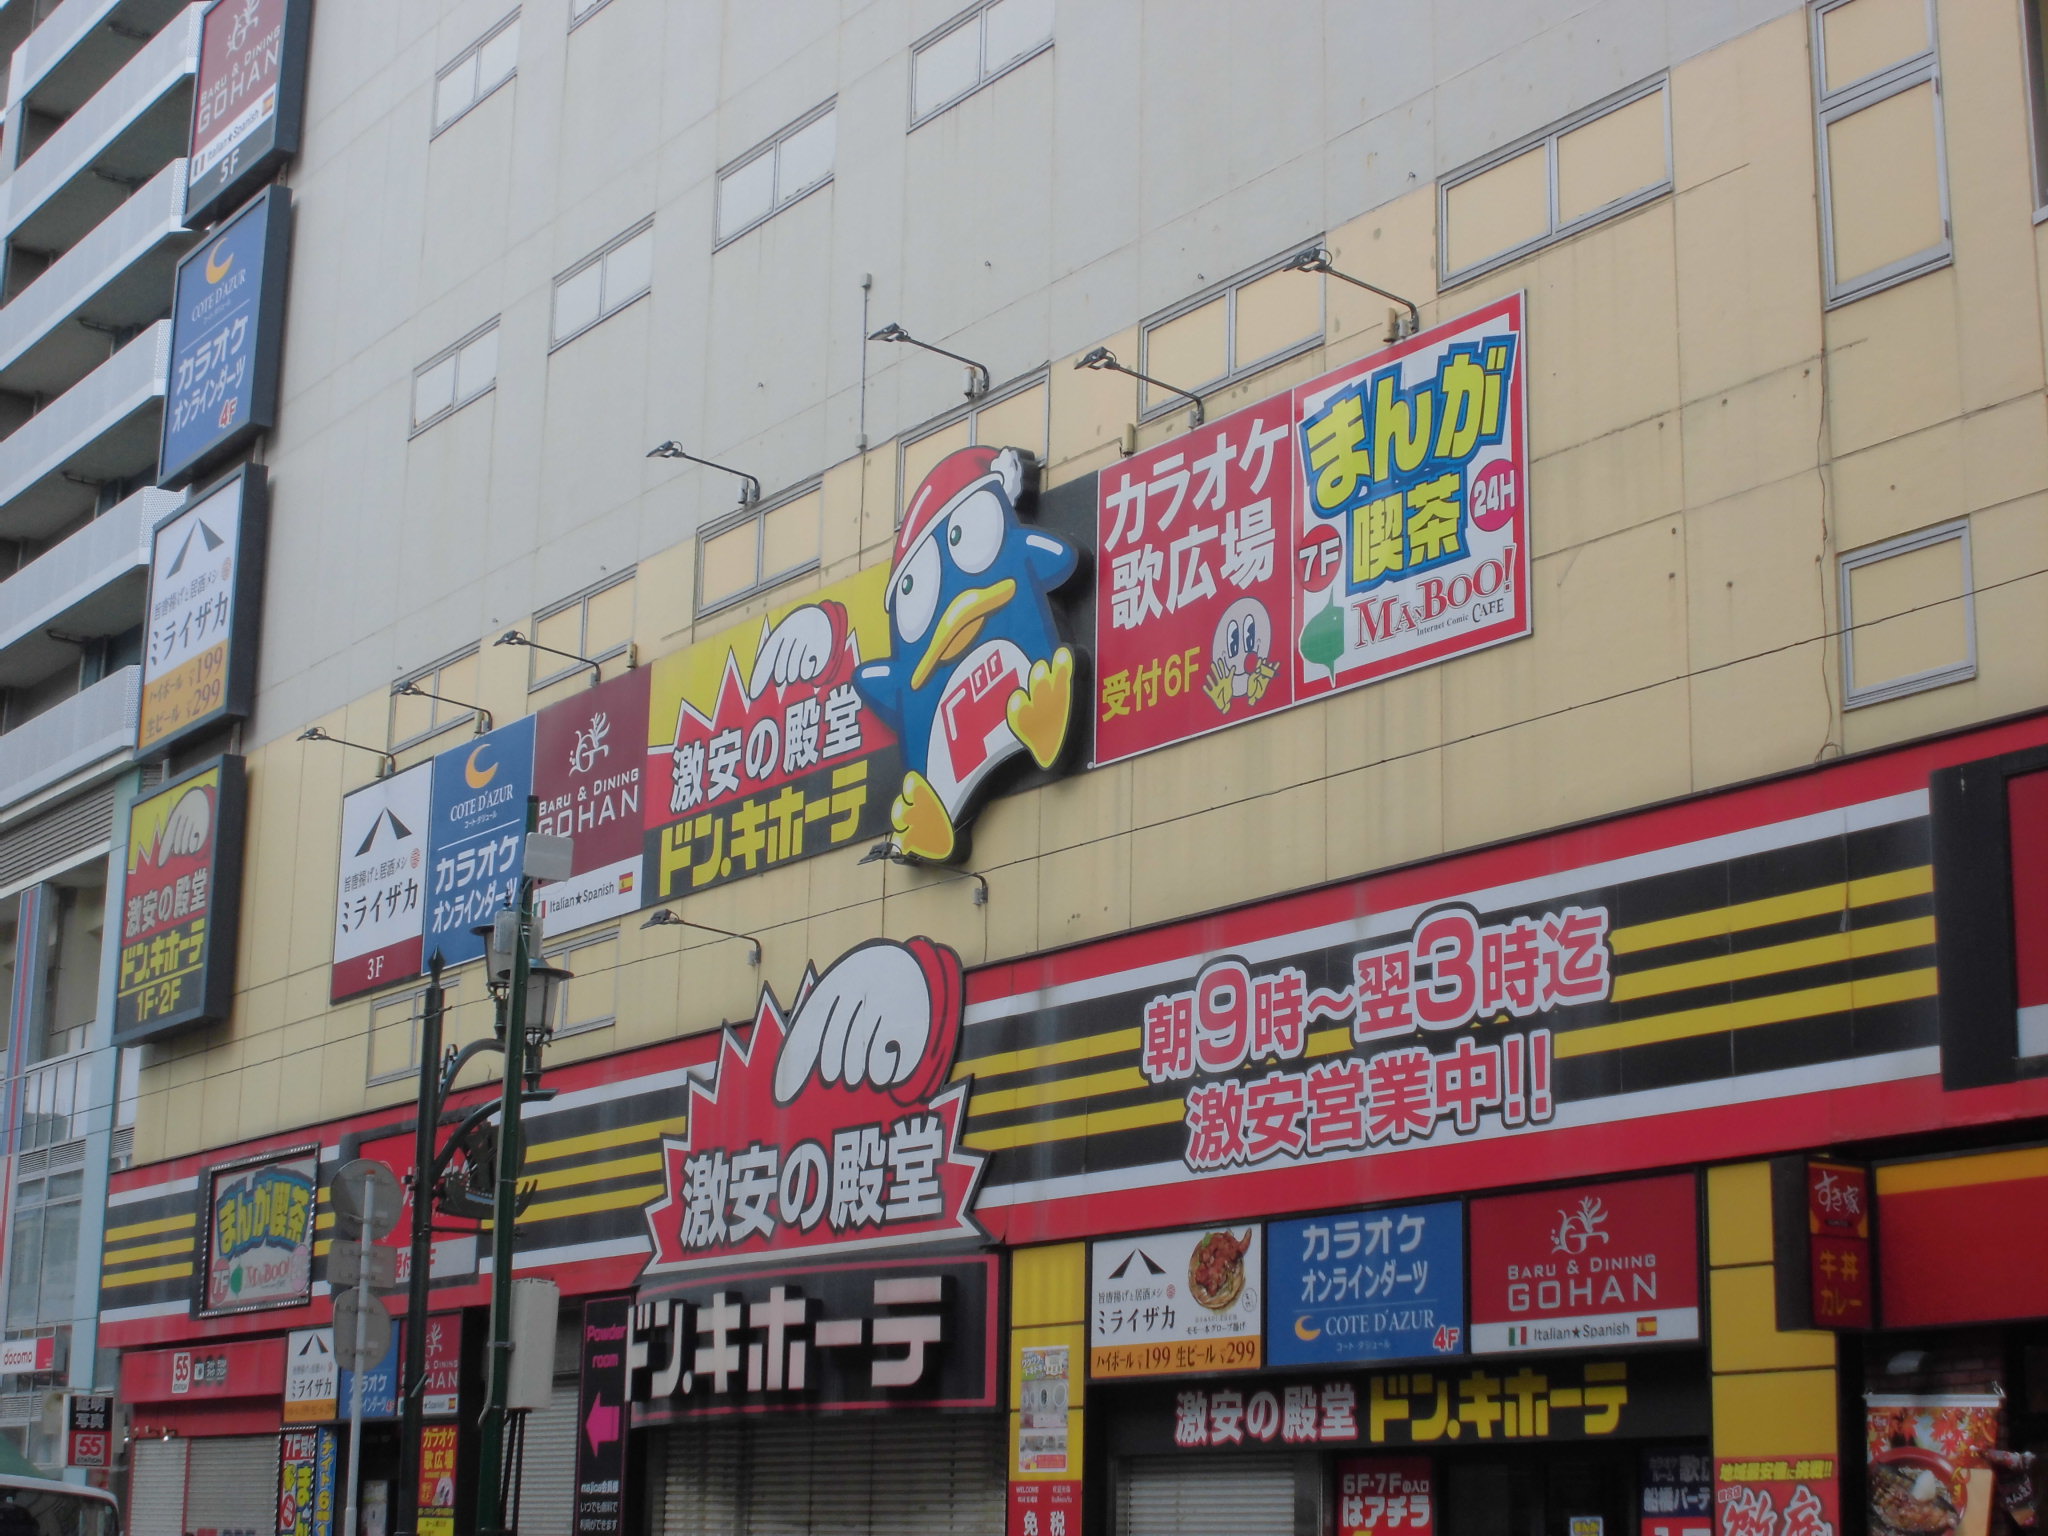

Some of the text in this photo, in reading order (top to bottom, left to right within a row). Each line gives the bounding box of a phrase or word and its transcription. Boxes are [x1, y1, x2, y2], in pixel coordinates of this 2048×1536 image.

[198, 40, 280, 134] GOHAN
[201, 77, 228, 105] BARU
[244, 25, 281, 66] DINING
[219, 148, 240, 184] 5F
[192, 291, 214, 322] COTE
[176, 315, 249, 395] カラオケ
[172, 355, 247, 433] オンラインダーツ
[218, 396, 238, 429] 4F
[1303, 341, 1512, 511] まんが
[1104, 417, 1290, 552] カラオケ
[1473, 468, 1517, 523] 24H
[1351, 471, 1463, 585] 喫茶
[1111, 497, 1277, 631] 歌広場
[1300, 535, 1341, 585] 7F
[151, 591, 229, 666] ミライザカ
[1416, 598, 1505, 638] Internet Comic CAFE
[1101, 646, 1201, 723] 受付6F
[670, 684, 863, 814] 激安の殿堂
[450, 784, 514, 822] COTE D'AZUR
[538, 767, 639, 818] BARU & DINING
[435, 835, 519, 895] カラオケ
[126, 866, 208, 938] 激安の殿堂
[342, 877, 419, 933] ミライザカ
[432, 877, 519, 934] オンラインダーツ
[367, 955, 385, 981] 3F
[680, 1115, 944, 1248] 激安の殿堂
[218, 1180, 310, 1254] まんが喫茶
[1302, 1213, 1426, 1263] カラオケ
[1300, 1259, 1429, 1303] オンラインダーツ
[1508, 1253, 1657, 1281] BARU & DINING
[1820, 1250, 1859, 1280] 牛丼
[1508, 1271, 1657, 1312] GOHAN
[1820, 1287, 1862, 1316] カレー
[1097, 1305, 1177, 1336] ミライザカ
[1325, 1308, 1435, 1337] COTE D'AZUR
[1432, 1324, 1460, 1352] 4F
[3, 1351, 33, 1366] docomo
[176, 1355, 189, 1381] 55
[591, 1353, 619, 1369] room
[1096, 1350, 1134, 1370] ハイボール
[1175, 1343, 1216, 1368] 生ビール
[292, 1378, 332, 1399] ミライザカ
[1175, 1384, 1359, 1444] 激安の殿堂
[79, 1437, 102, 1456] 55
[423, 1427, 456, 1449] カラオケ
[424, 1449, 454, 1470] 歌広場
[1342, 1495, 1430, 1528] はアチラ
